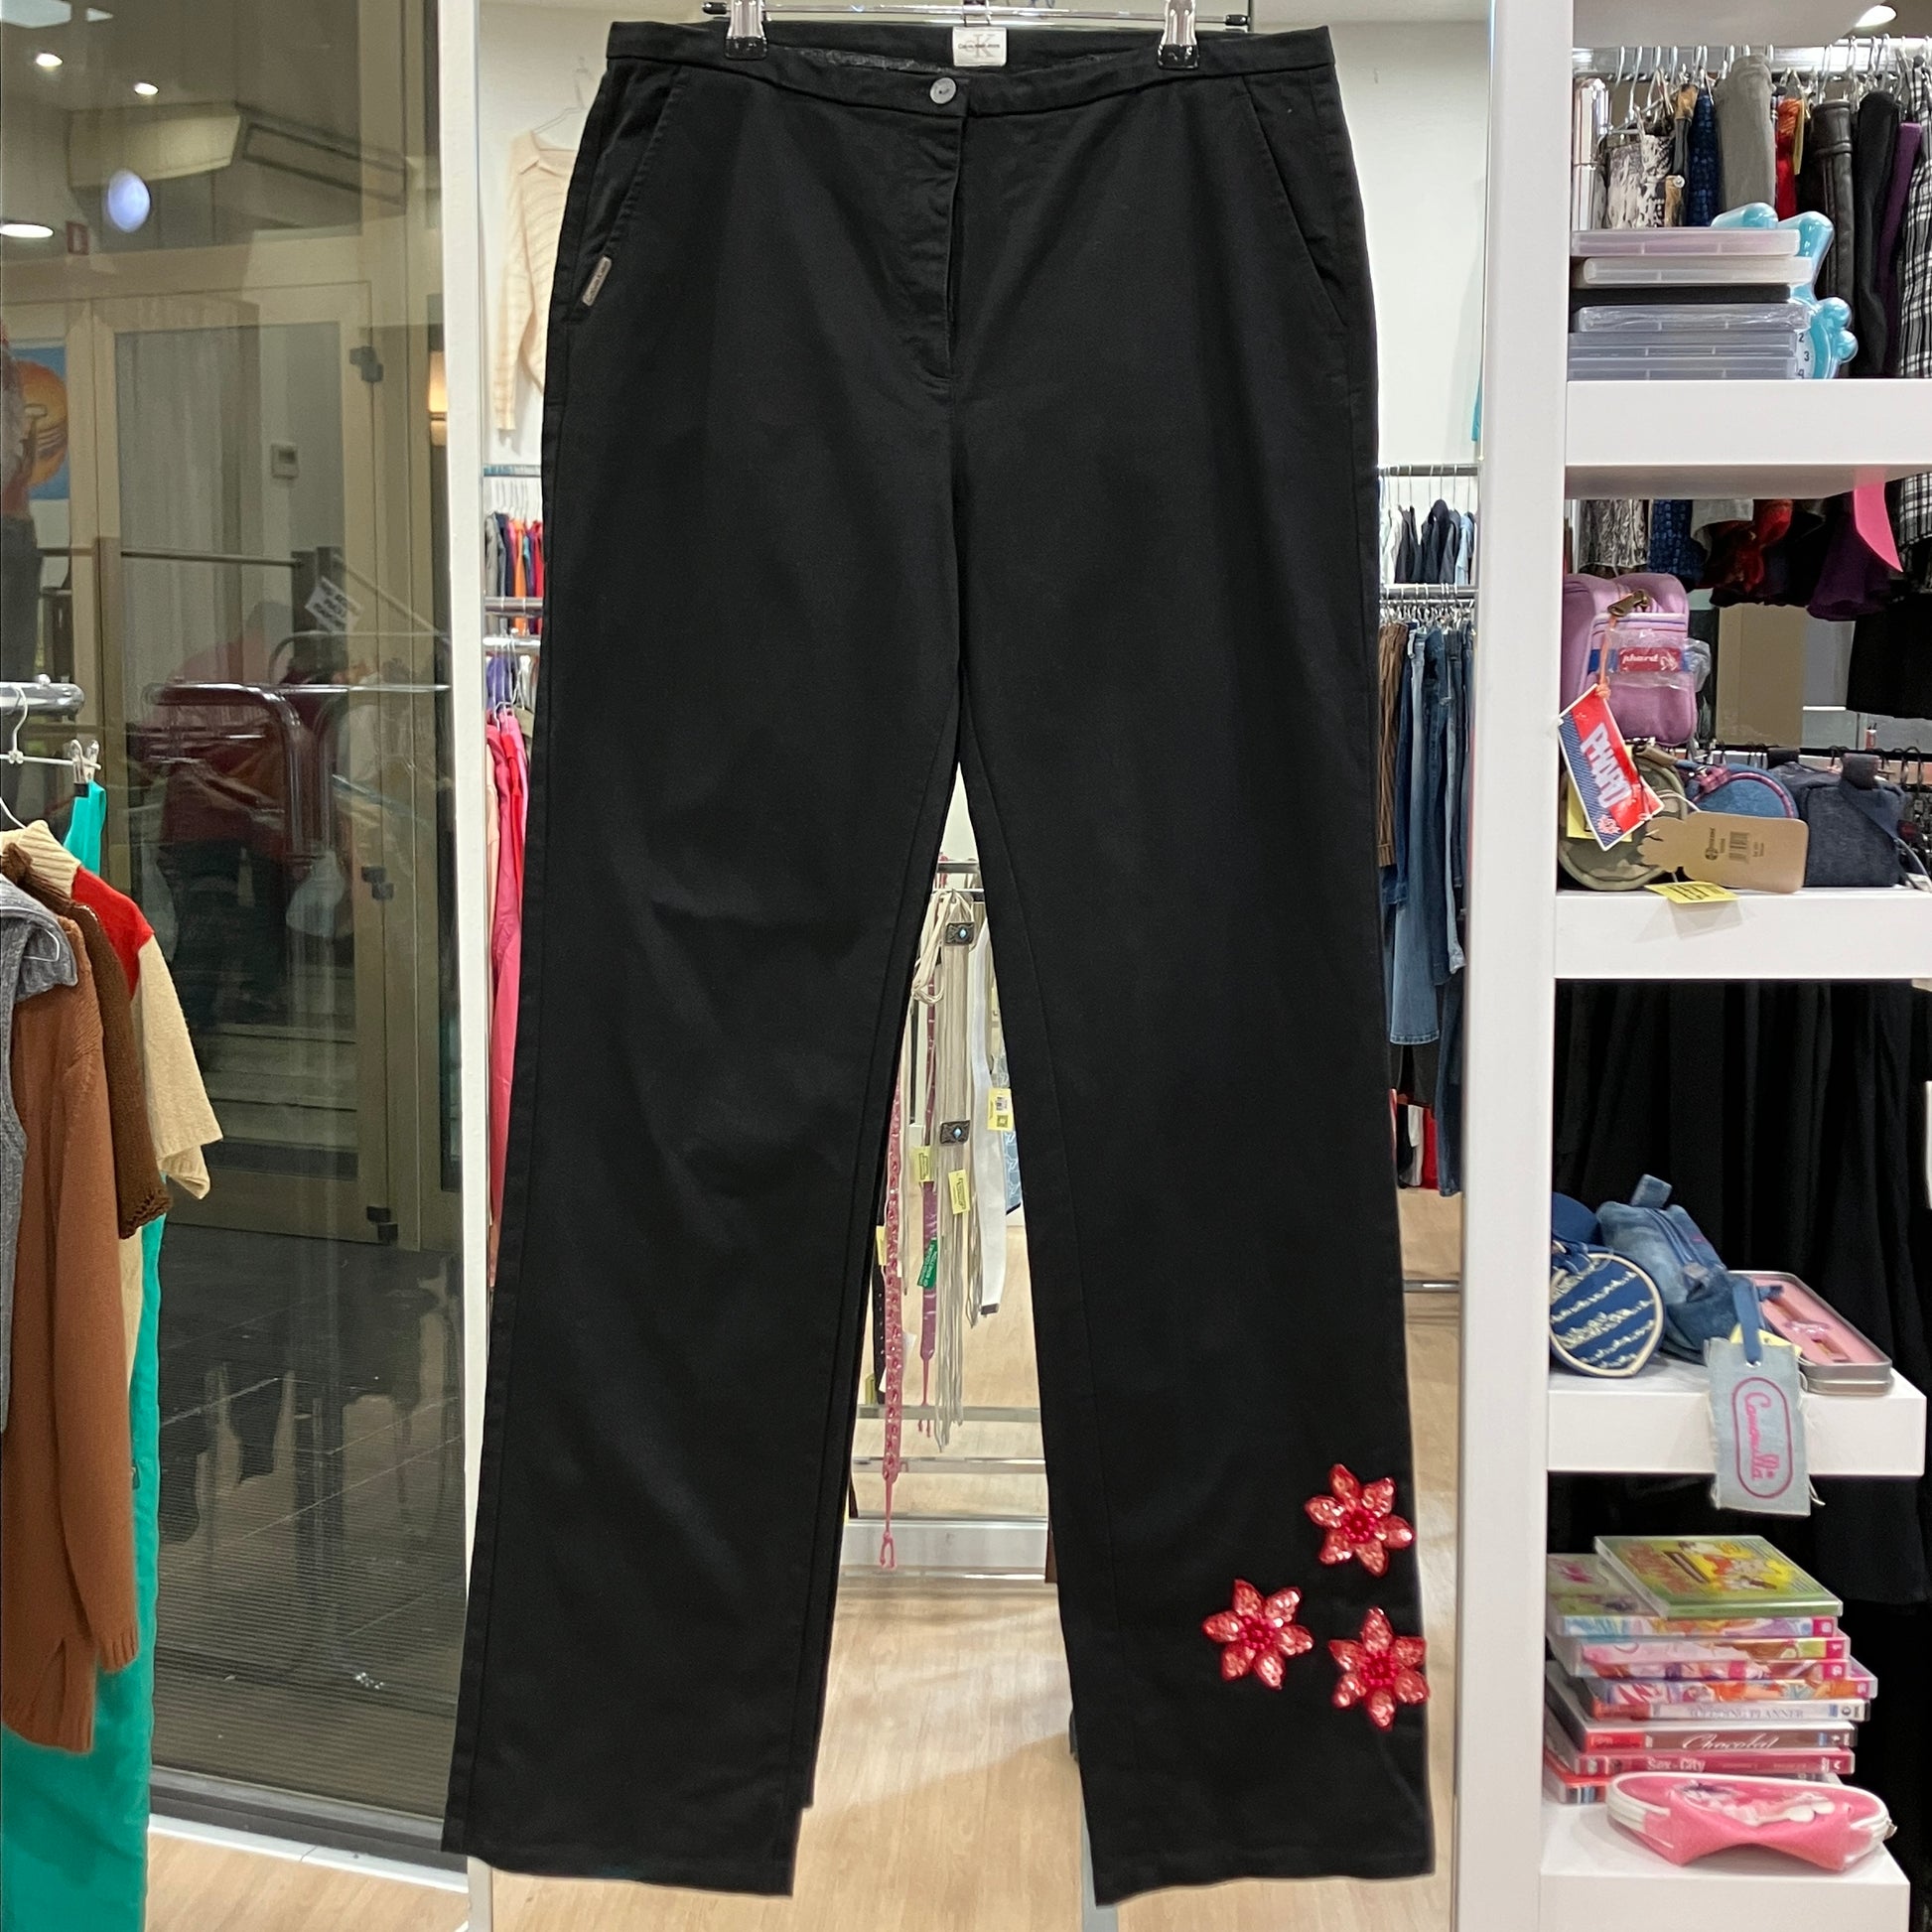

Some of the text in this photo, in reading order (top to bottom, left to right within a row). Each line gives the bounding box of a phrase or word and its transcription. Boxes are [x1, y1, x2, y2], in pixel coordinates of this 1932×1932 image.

[1798, 332, 1805, 344] 2
[1803, 350, 1810, 362] 3
[1749, 1708, 1804, 1719] PLANNER
